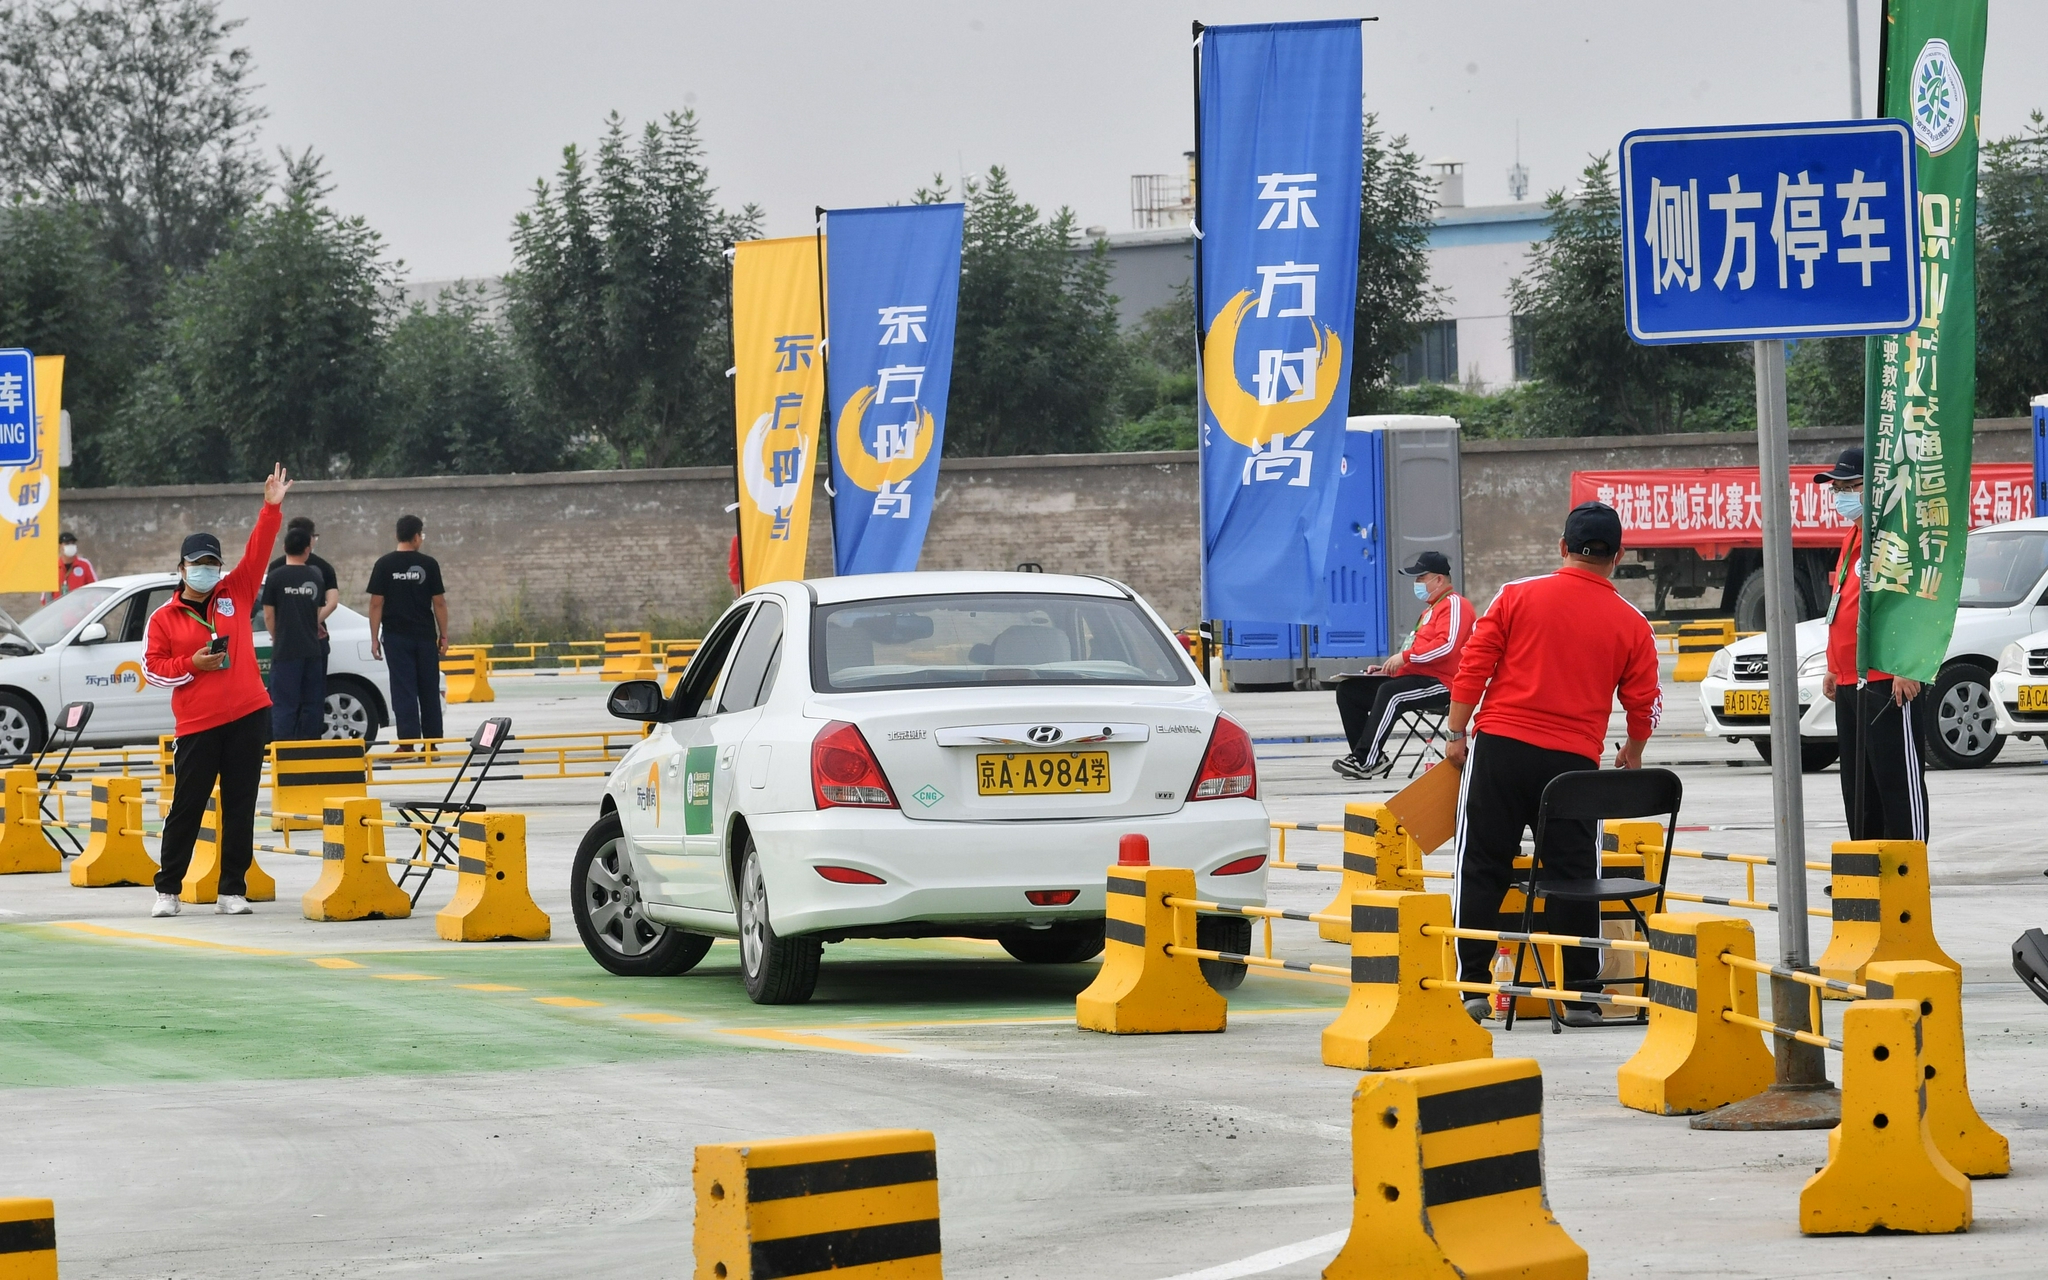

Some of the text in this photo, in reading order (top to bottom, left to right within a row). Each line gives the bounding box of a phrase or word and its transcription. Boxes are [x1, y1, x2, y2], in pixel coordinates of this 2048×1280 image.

[1644, 168, 1891, 295] 侧方停车
[1243, 172, 1320, 487] 东方时尚
[770, 334, 814, 541] 东方时尚
[872, 305, 927, 519] 东方时尚
[85, 673, 136, 686] 东方时尚
[919, 791, 937, 800] CNG
[981, 758, 1106, 789] 京A·A984学
